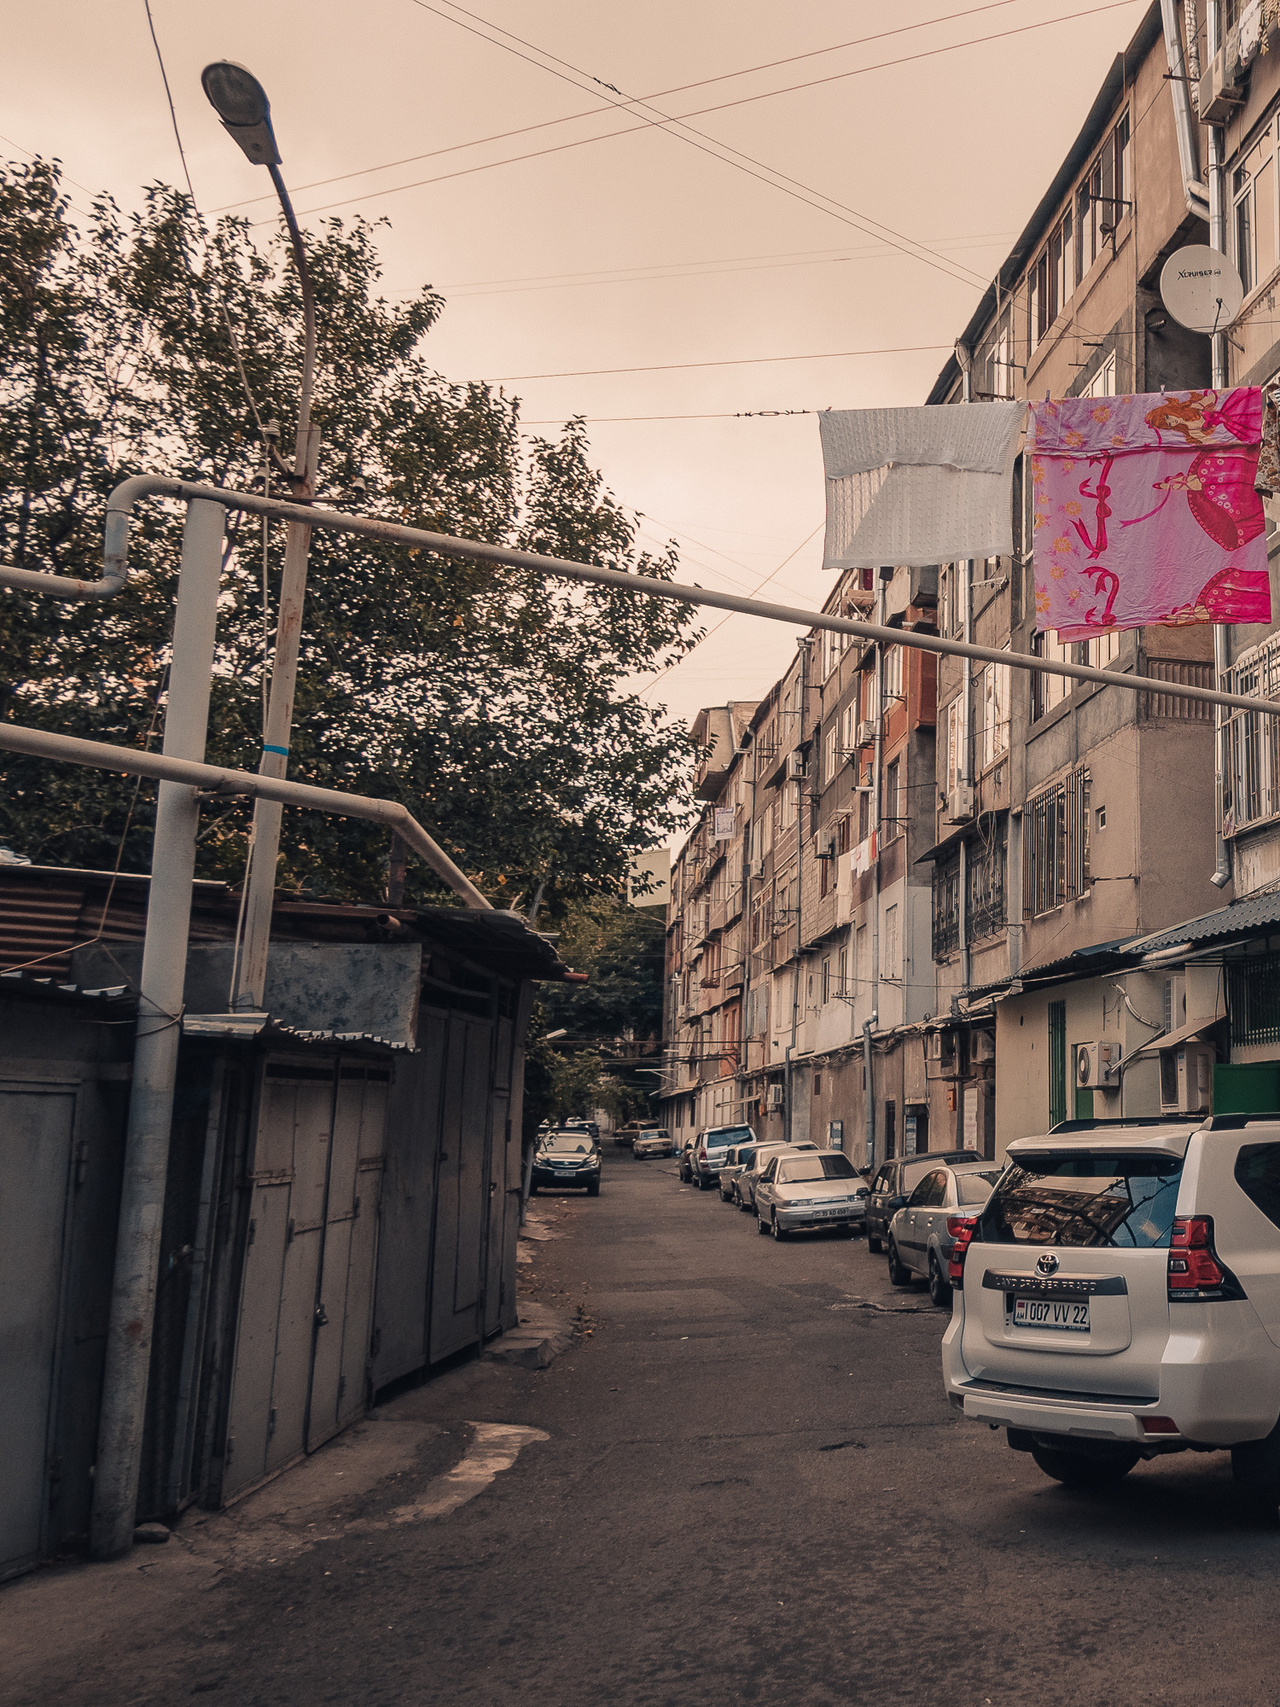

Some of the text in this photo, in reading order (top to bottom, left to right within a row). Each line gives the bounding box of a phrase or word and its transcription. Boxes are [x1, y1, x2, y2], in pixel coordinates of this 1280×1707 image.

[1177, 269, 1212, 281] XCRUISER
[1020, 1279, 1059, 1289] CRUISER
[1062, 1281, 1097, 1291] PRADO
[1053, 1304, 1070, 1323] VV
[1072, 1305, 1088, 1324] 22
